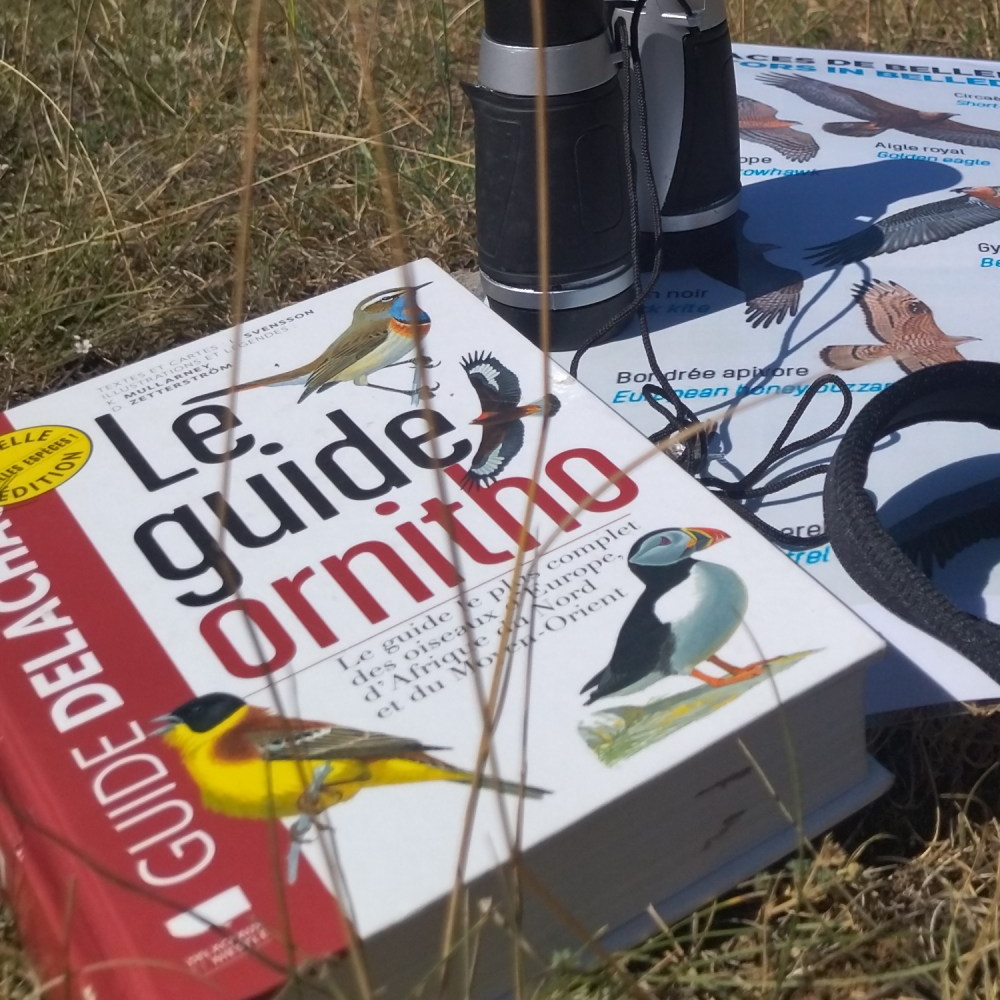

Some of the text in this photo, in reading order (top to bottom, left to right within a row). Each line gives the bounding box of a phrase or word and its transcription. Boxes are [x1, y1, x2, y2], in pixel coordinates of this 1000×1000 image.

[740, 61, 816, 72] ORS
[828, 66, 864, 75] IN
[827, 59, 874, 70] DE
[740, 156, 772, 165] ope
[875, 142, 966, 156] Aigle royal
[876, 151, 991, 168] Golden eagle
[741, 167, 819, 177] owhawk
[667, 288, 709, 299] noir
[169, 345, 219, 366] CARTES
[244, 309, 315, 338] SVENSSON
[124, 363, 210, 399] MULLARNEY
[130, 363, 233, 406] ZETTERSTRÖM
[722, 364, 809, 380] apivore
[0, 430, 53, 450] ELLE
[94, 404, 255, 492] Le
[133, 408, 472, 607] guide
[199, 448, 639, 679] ornitho
[337, 650, 374, 671] Le
[382, 611, 454, 654] guide
[547, 521, 641, 570] complet
[534, 579, 598, 617] Nord
[352, 660, 397, 687] des
[404, 610, 499, 661] oiseaux
[377, 587, 629, 719] et du Moen-Orient
[0, 506, 215, 887] GUIDE DELACH
